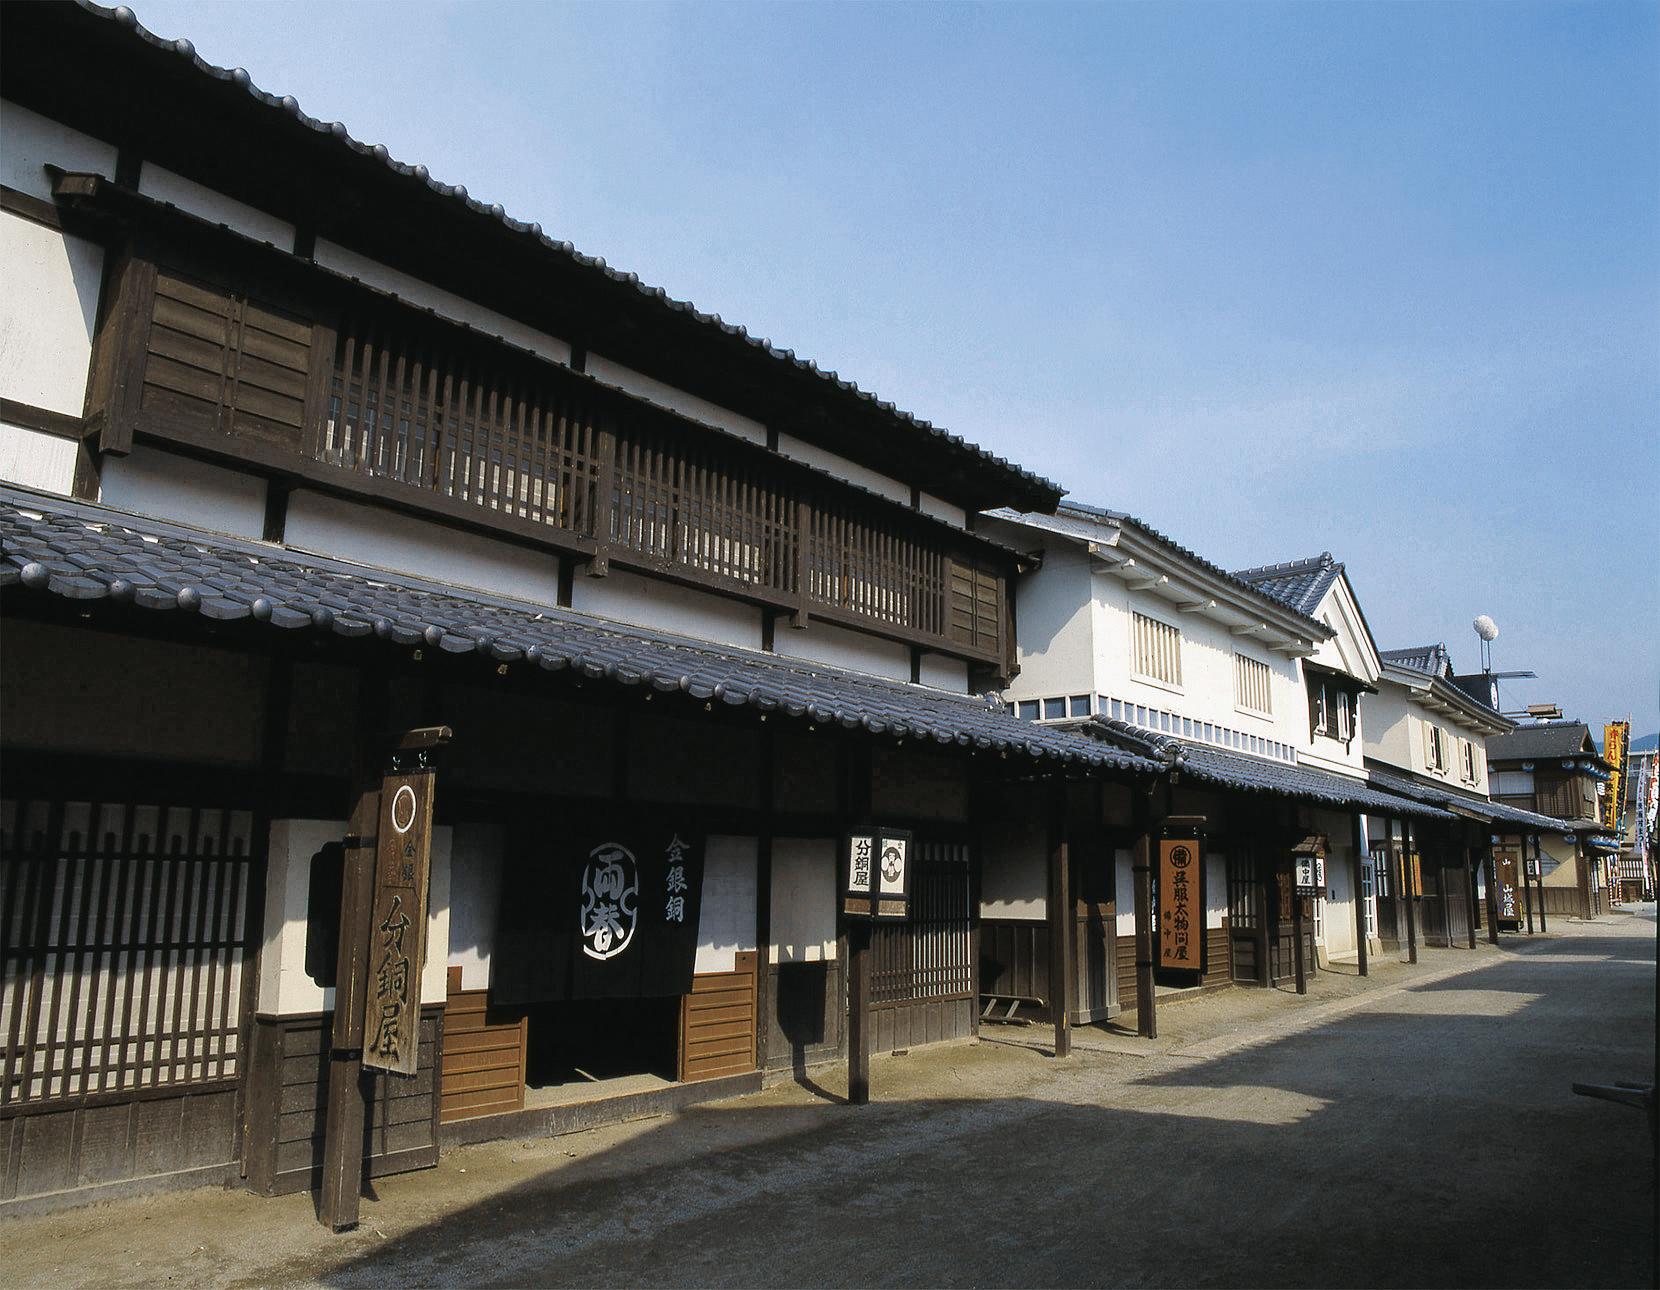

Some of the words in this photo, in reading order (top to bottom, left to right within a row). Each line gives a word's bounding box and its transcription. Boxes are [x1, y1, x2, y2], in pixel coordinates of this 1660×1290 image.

[665, 832, 690, 923] 金銀銅
[853, 839, 872, 886] 分銅屋
[370, 895, 412, 1062] 分銅屋
